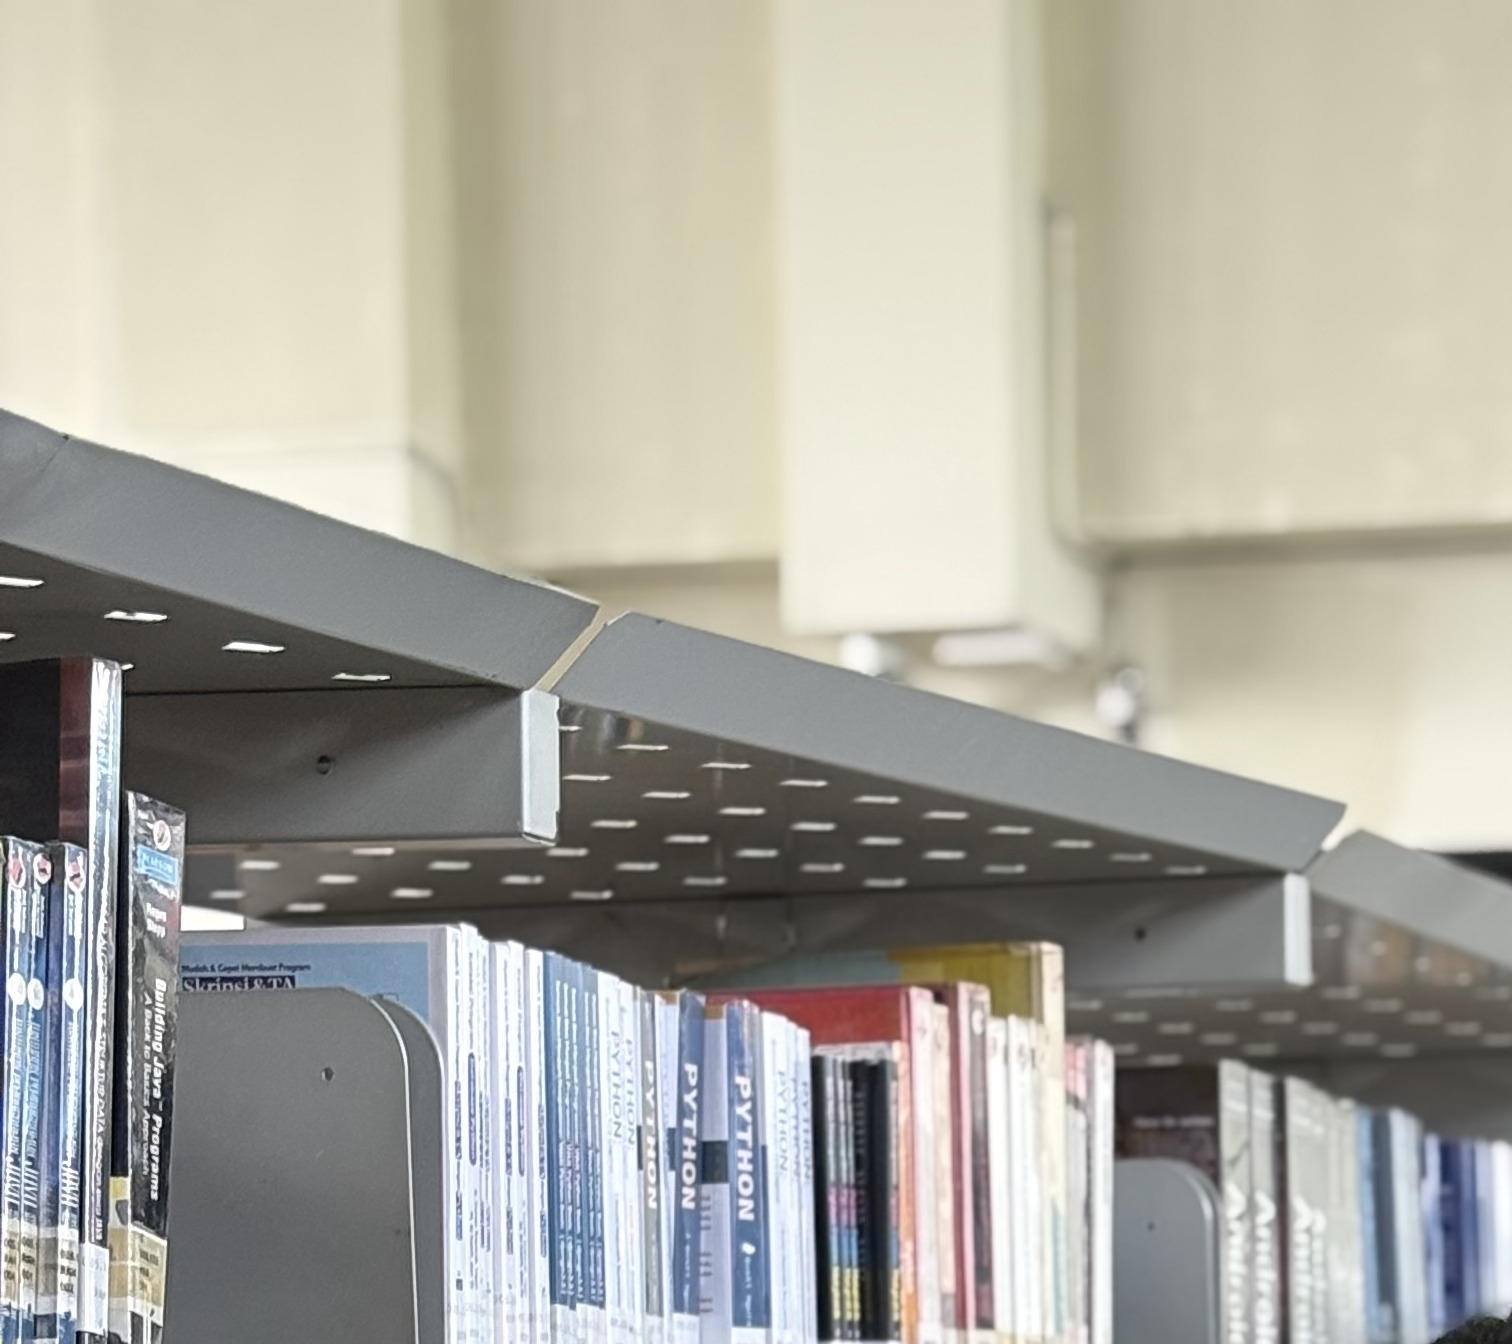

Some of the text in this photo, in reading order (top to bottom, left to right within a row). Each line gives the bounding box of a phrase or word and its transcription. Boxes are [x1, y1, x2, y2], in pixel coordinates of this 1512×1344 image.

[149, 980, 168, 1200] Building Programs
[645, 1060, 657, 1209] PYTHON
[681, 1063, 698, 1210] PYTHON
[735, 1075, 754, 1221] PYTHON
